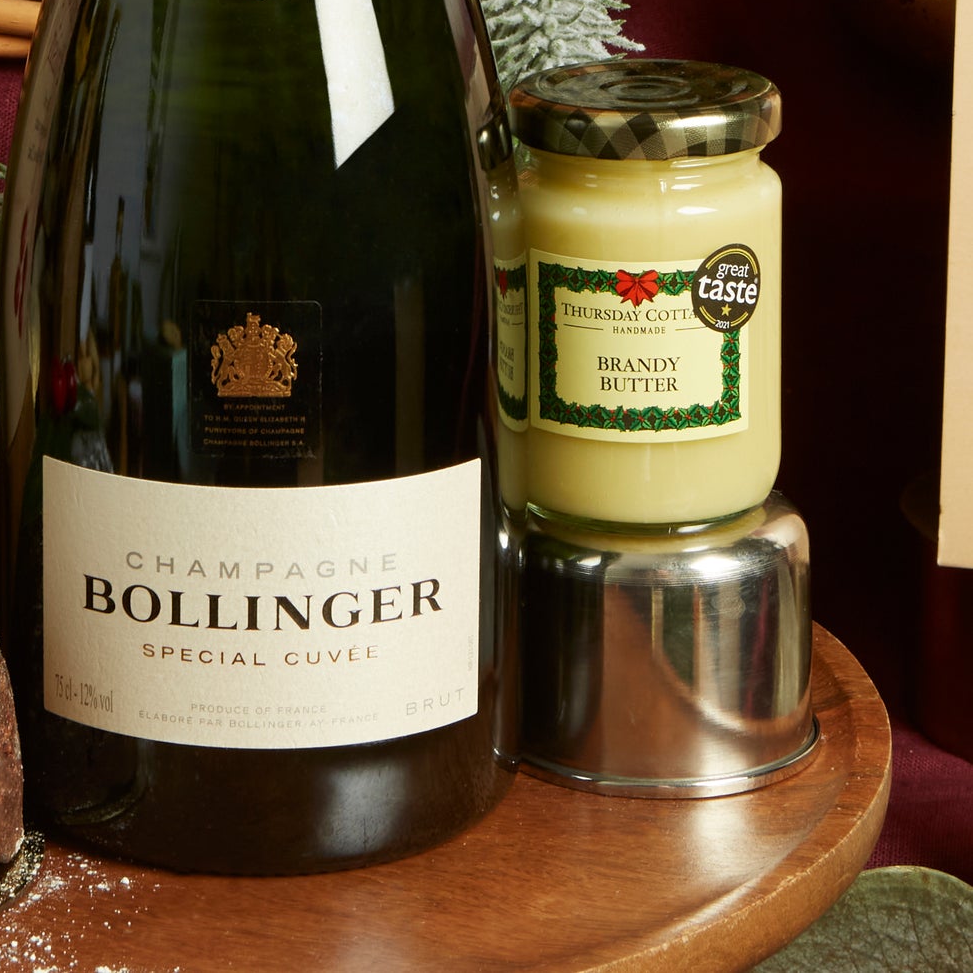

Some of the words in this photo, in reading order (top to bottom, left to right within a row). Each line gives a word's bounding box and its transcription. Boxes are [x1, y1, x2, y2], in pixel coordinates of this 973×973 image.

[716, 263, 750, 279] great
[561, 302, 642, 322] THURSDAY
[612, 326, 666, 335] HANDMADE
[715, 319, 730, 329] 2021
[597, 356, 681, 373] BRANDY
[600, 376, 679, 393] BUTTER
[126, 551, 397, 580] CHAMPAGNE
[83, 574, 443, 631] BOLLINGER
[142, 643, 266, 666] SPECIAL
[284, 644, 379, 666] CUVÉE
[99, 690, 113, 713] vol
[190, 703, 249, 715] PRODUCE
[255, 707, 271, 715] OF
[277, 705, 327, 715] FRANCE
[406, 687, 464, 715] BRUT
[198, 718, 223, 727] PAR
